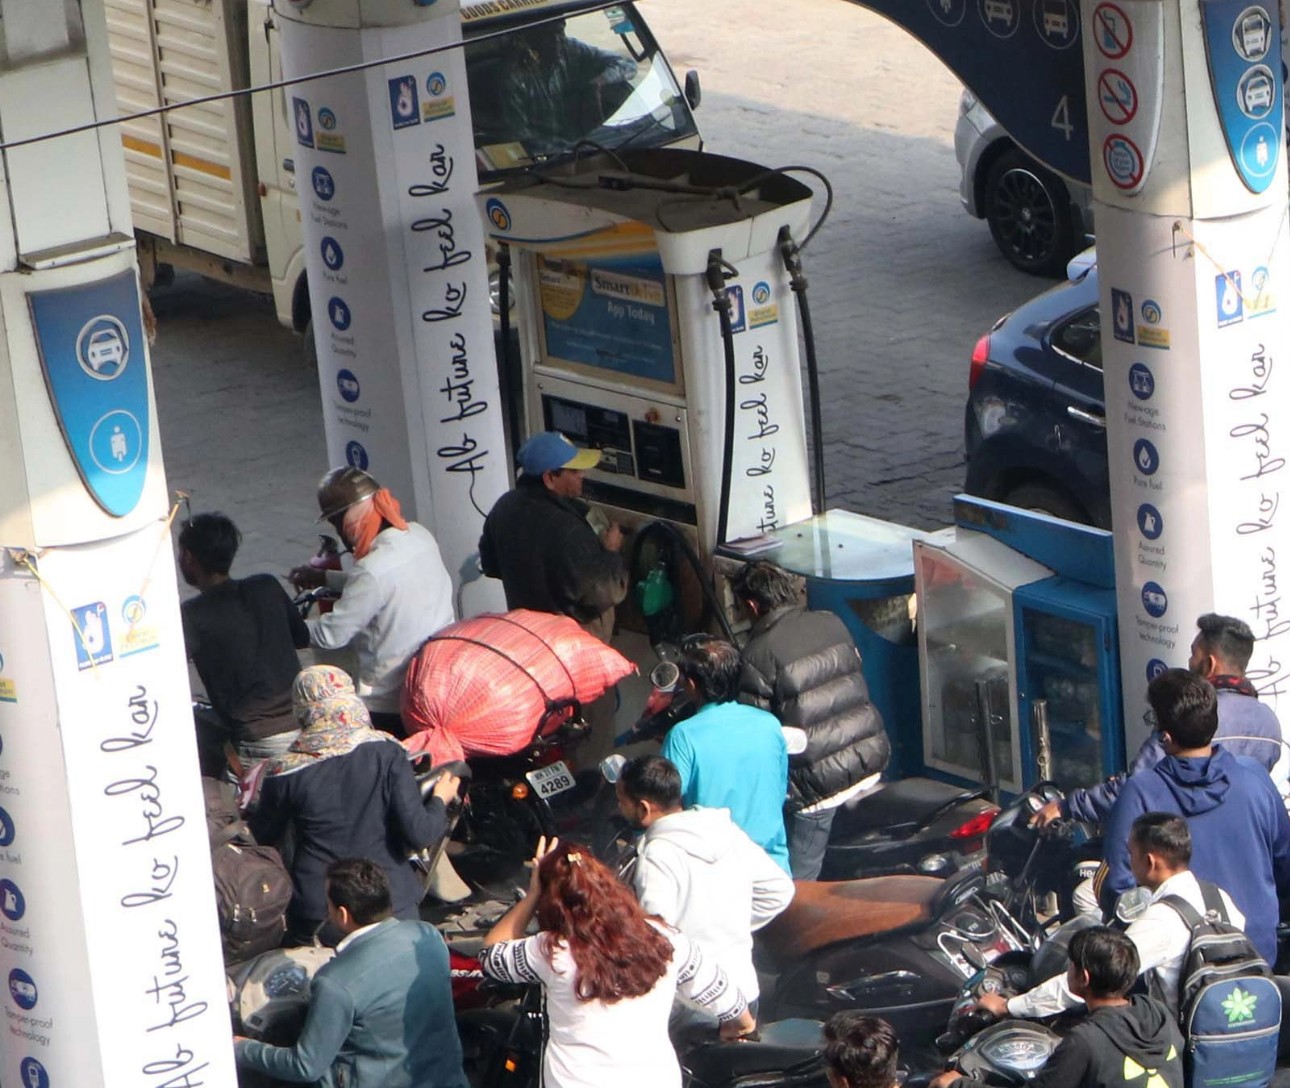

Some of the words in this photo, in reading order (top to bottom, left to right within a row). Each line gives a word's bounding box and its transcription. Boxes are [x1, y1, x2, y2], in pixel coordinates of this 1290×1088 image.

[1051, 95, 1073, 141] 4
[757, 485, 777, 532] ture
[104, 765, 185, 845] feel
[541, 775, 570, 795] 4289
[146, 919, 208, 1032] future
